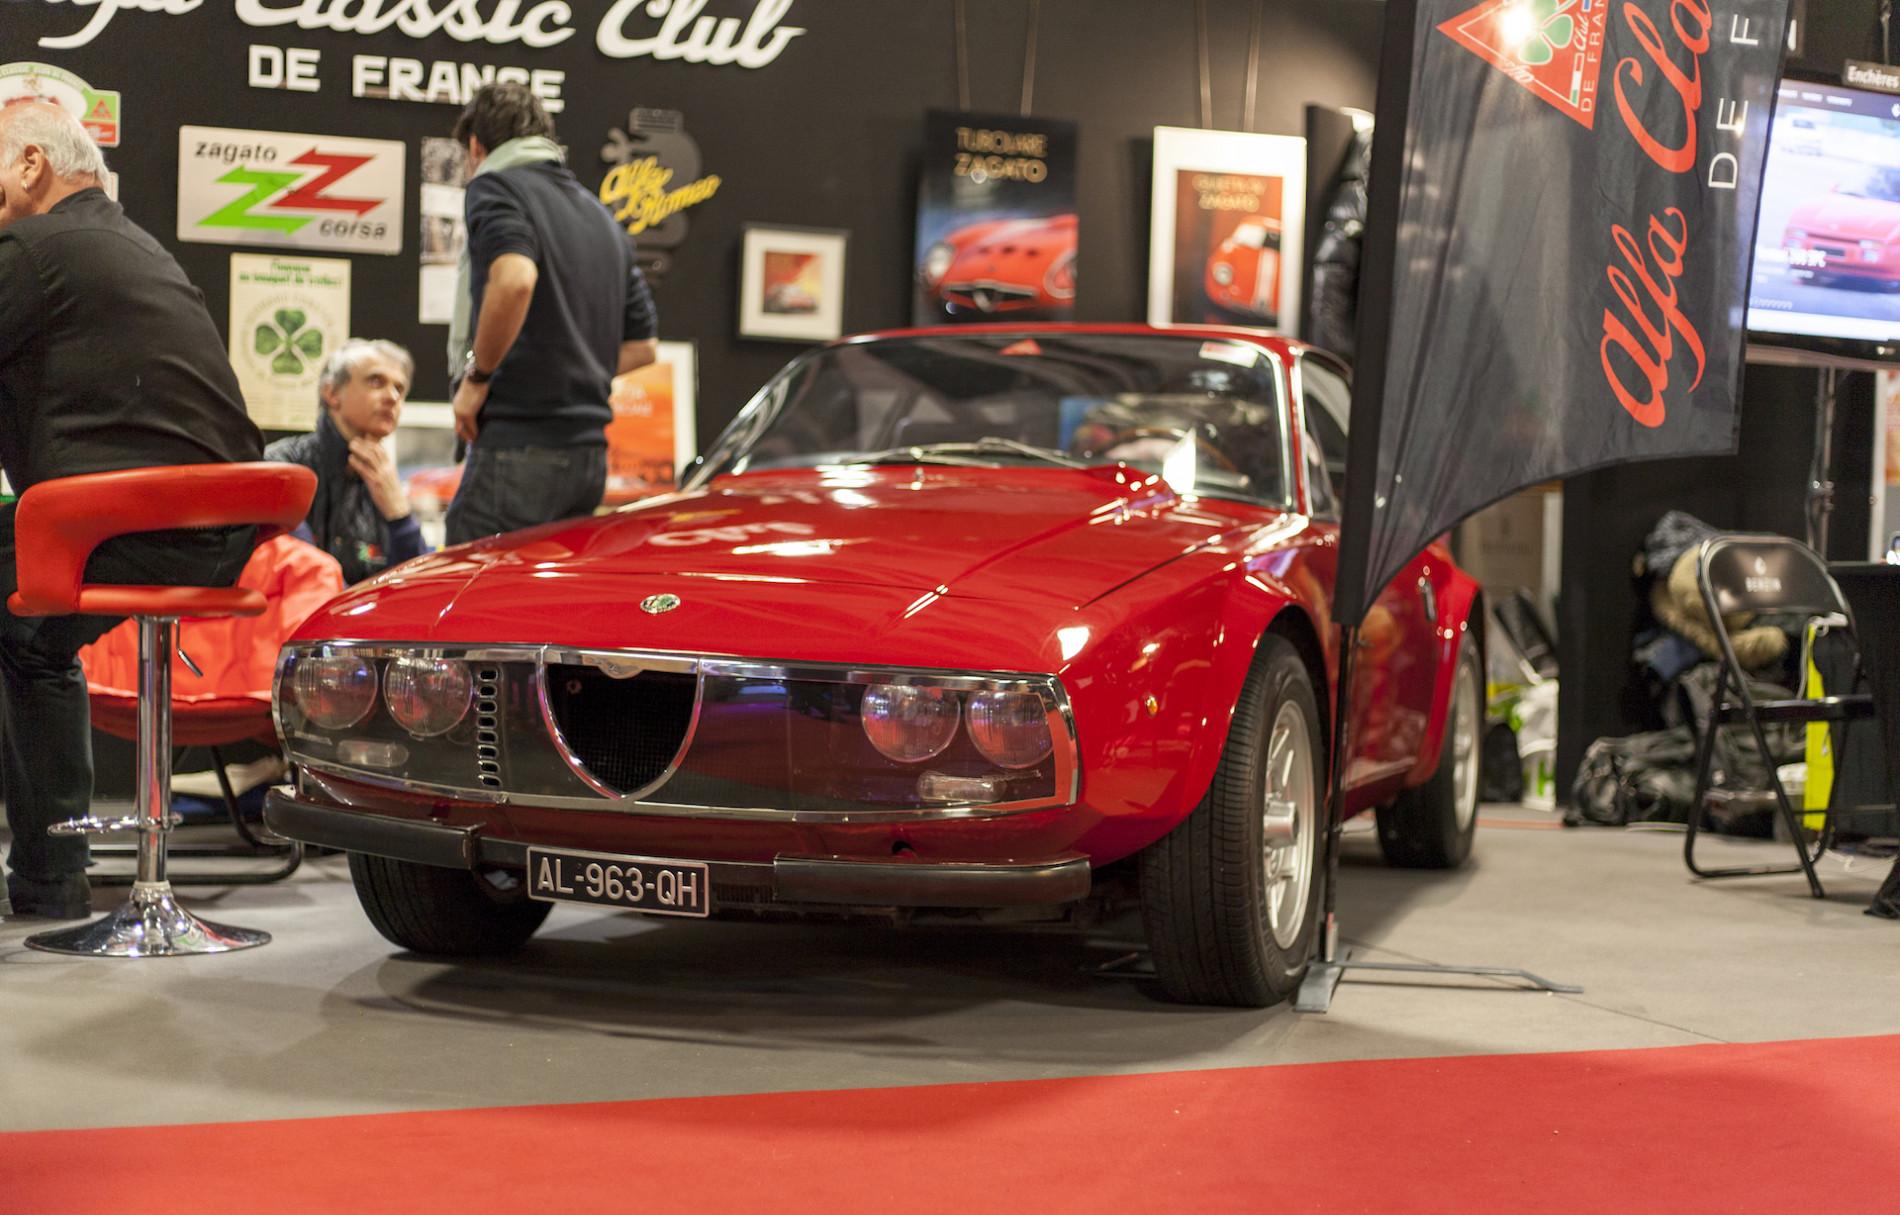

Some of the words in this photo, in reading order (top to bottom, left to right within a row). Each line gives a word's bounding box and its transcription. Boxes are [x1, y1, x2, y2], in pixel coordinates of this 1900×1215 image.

[249, 44, 321, 92] DE
[352, 54, 566, 112] FRANE
[1847, 65, 1900, 89] Enchères
[1580, 80, 1595, 112] DE
[195, 141, 278, 165] zagato
[1708, 97, 1749, 189] DE
[953, 152, 1048, 183] ZAGATO
[319, 218, 388, 240] corsa
[537, 857, 697, 907] AL-963-QH
